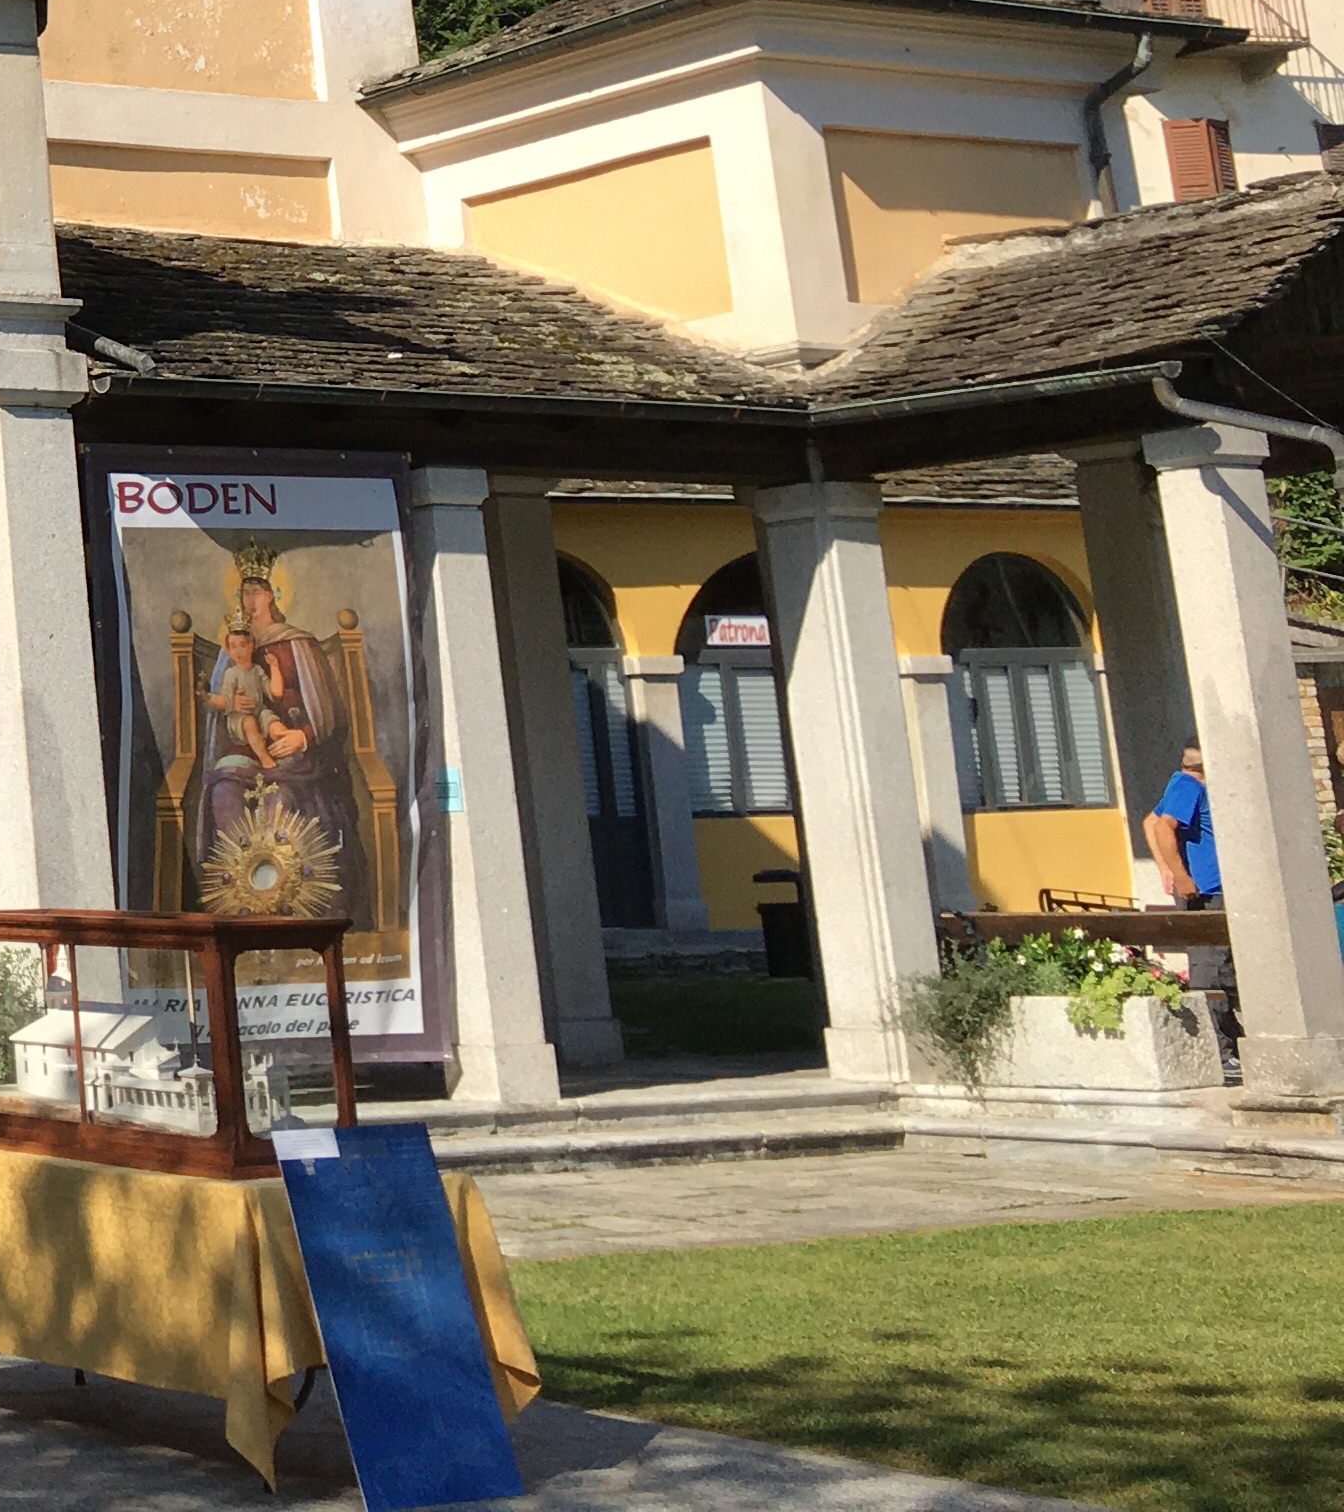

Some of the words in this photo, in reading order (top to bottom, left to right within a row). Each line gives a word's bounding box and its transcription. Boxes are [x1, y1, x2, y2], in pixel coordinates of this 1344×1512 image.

[117, 481, 277, 515] BODEN
[707, 616, 769, 643] Patrona
[235, 995, 278, 1010] NNA
[286, 988, 416, 1006] EUCRISTICA
[285, 1019, 314, 1033] del
[316, 1019, 360, 1034] pe
